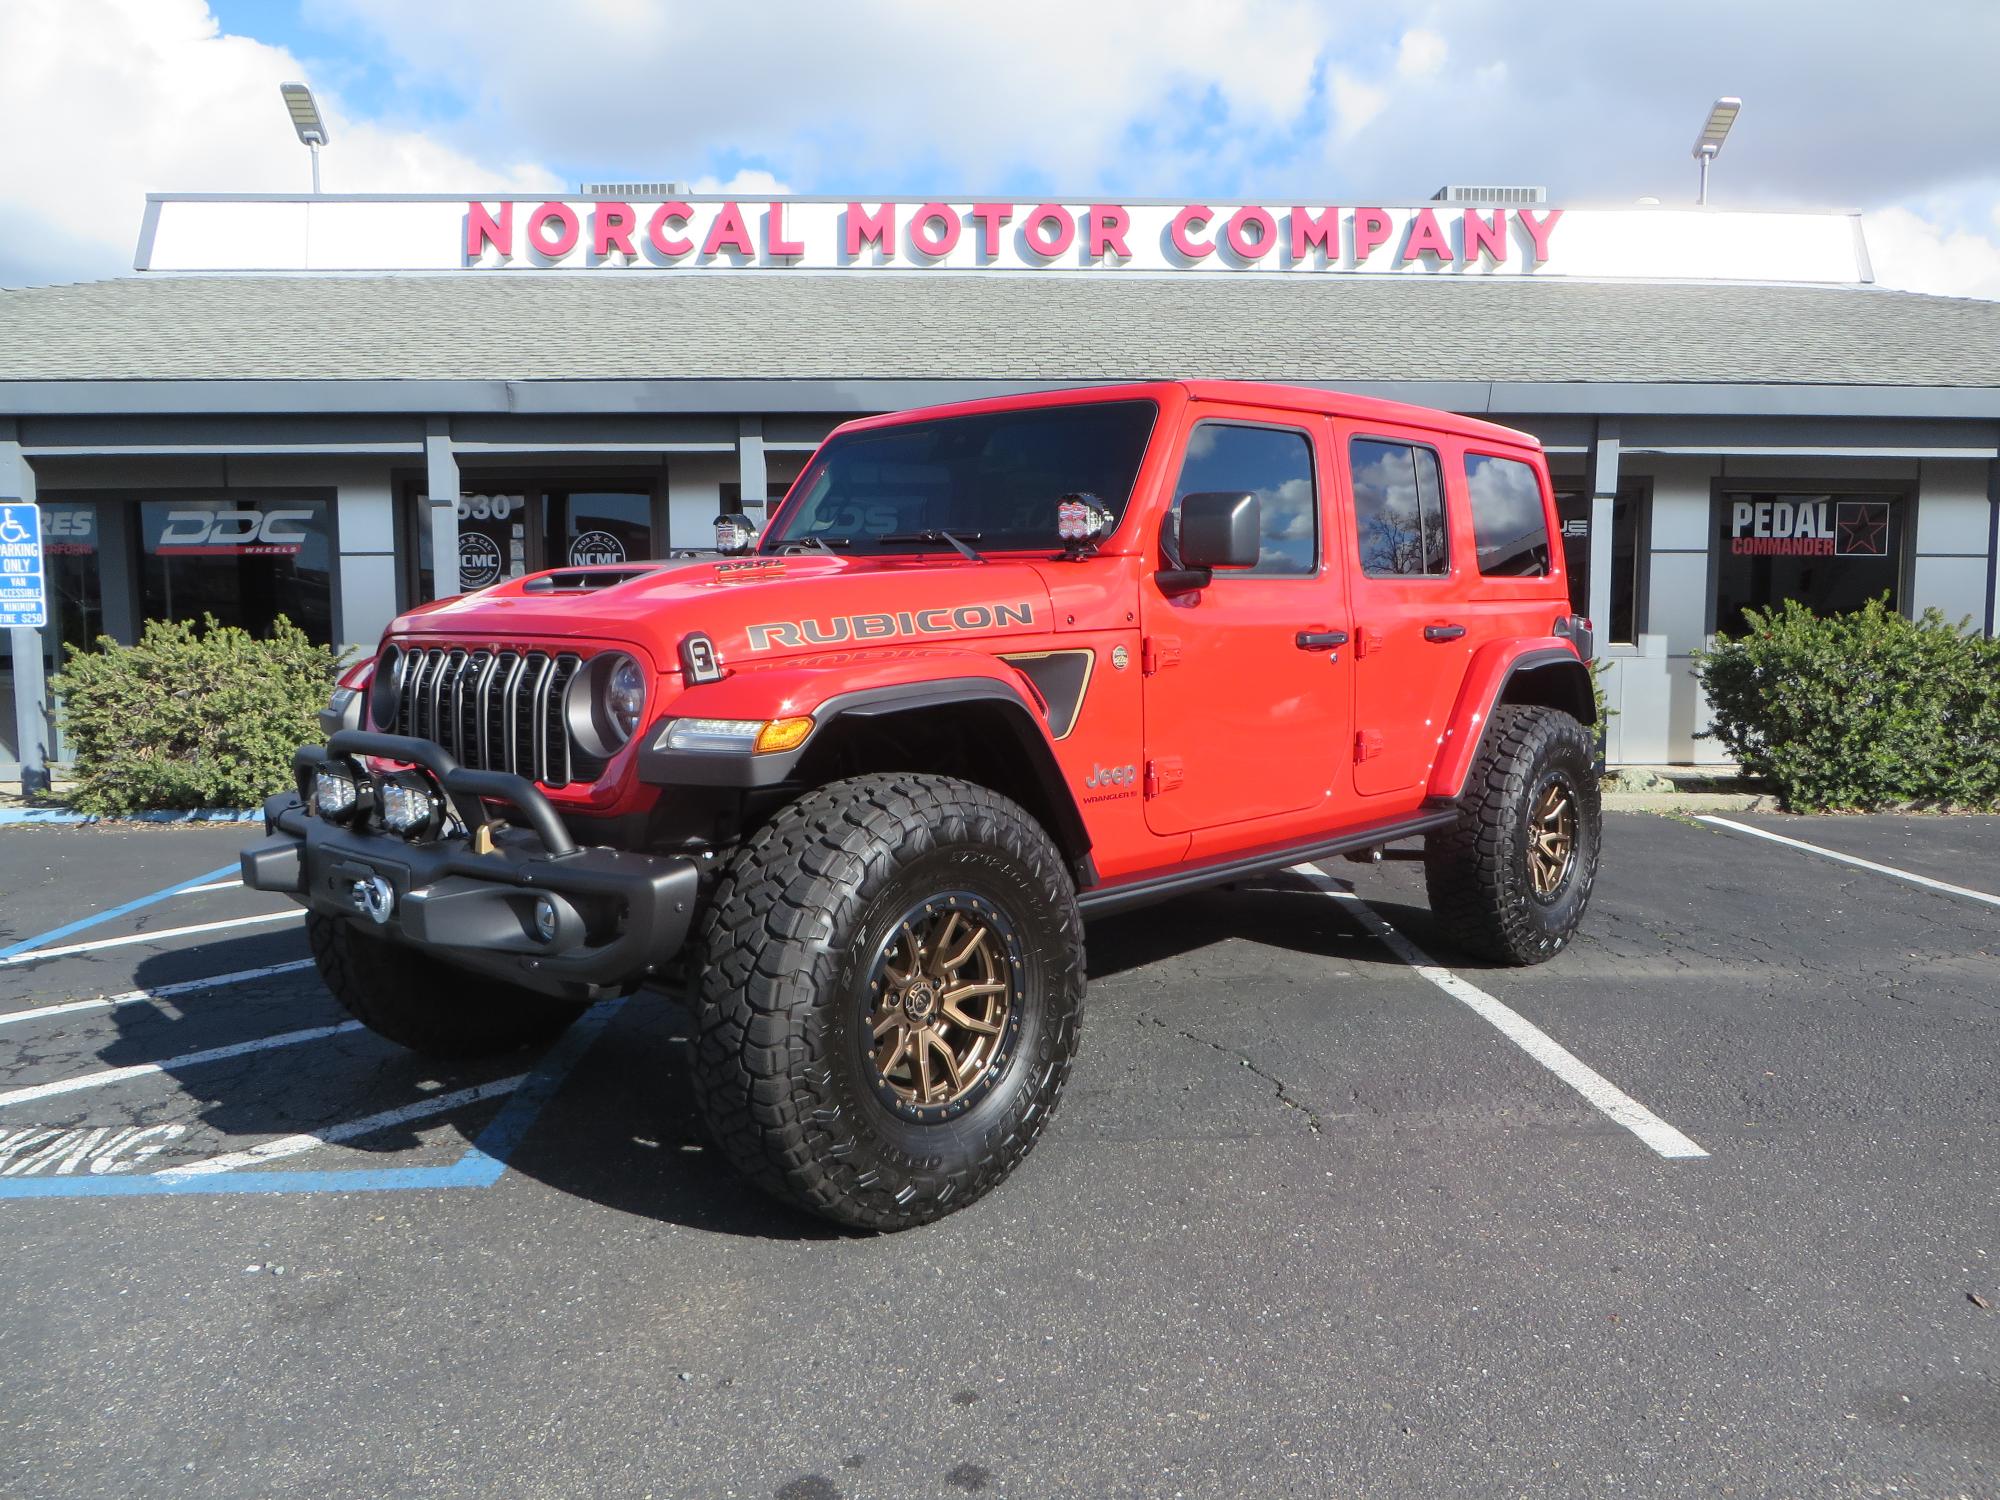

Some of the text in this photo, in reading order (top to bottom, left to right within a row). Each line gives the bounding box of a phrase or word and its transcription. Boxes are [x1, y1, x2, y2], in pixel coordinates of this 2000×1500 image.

[467, 201, 1565, 263] NORCAL MOTOR COMPANY
[159, 510, 314, 544] DDC
[1732, 502, 1835, 538] PEDAL
[245, 546, 297, 554] WHEELS
[1732, 537, 1835, 555] COMMANDER
[3, 558, 30, 573] ONLY
[573, 552, 622, 567] NCMC
[10, 576, 27, 587] VAN
[3, 601, 37, 612] MINIMUM
[746, 602, 1034, 651] RUBICON
[1085, 763, 1136, 788] Jeep
[1083, 791, 1130, 804] WRANGLER
